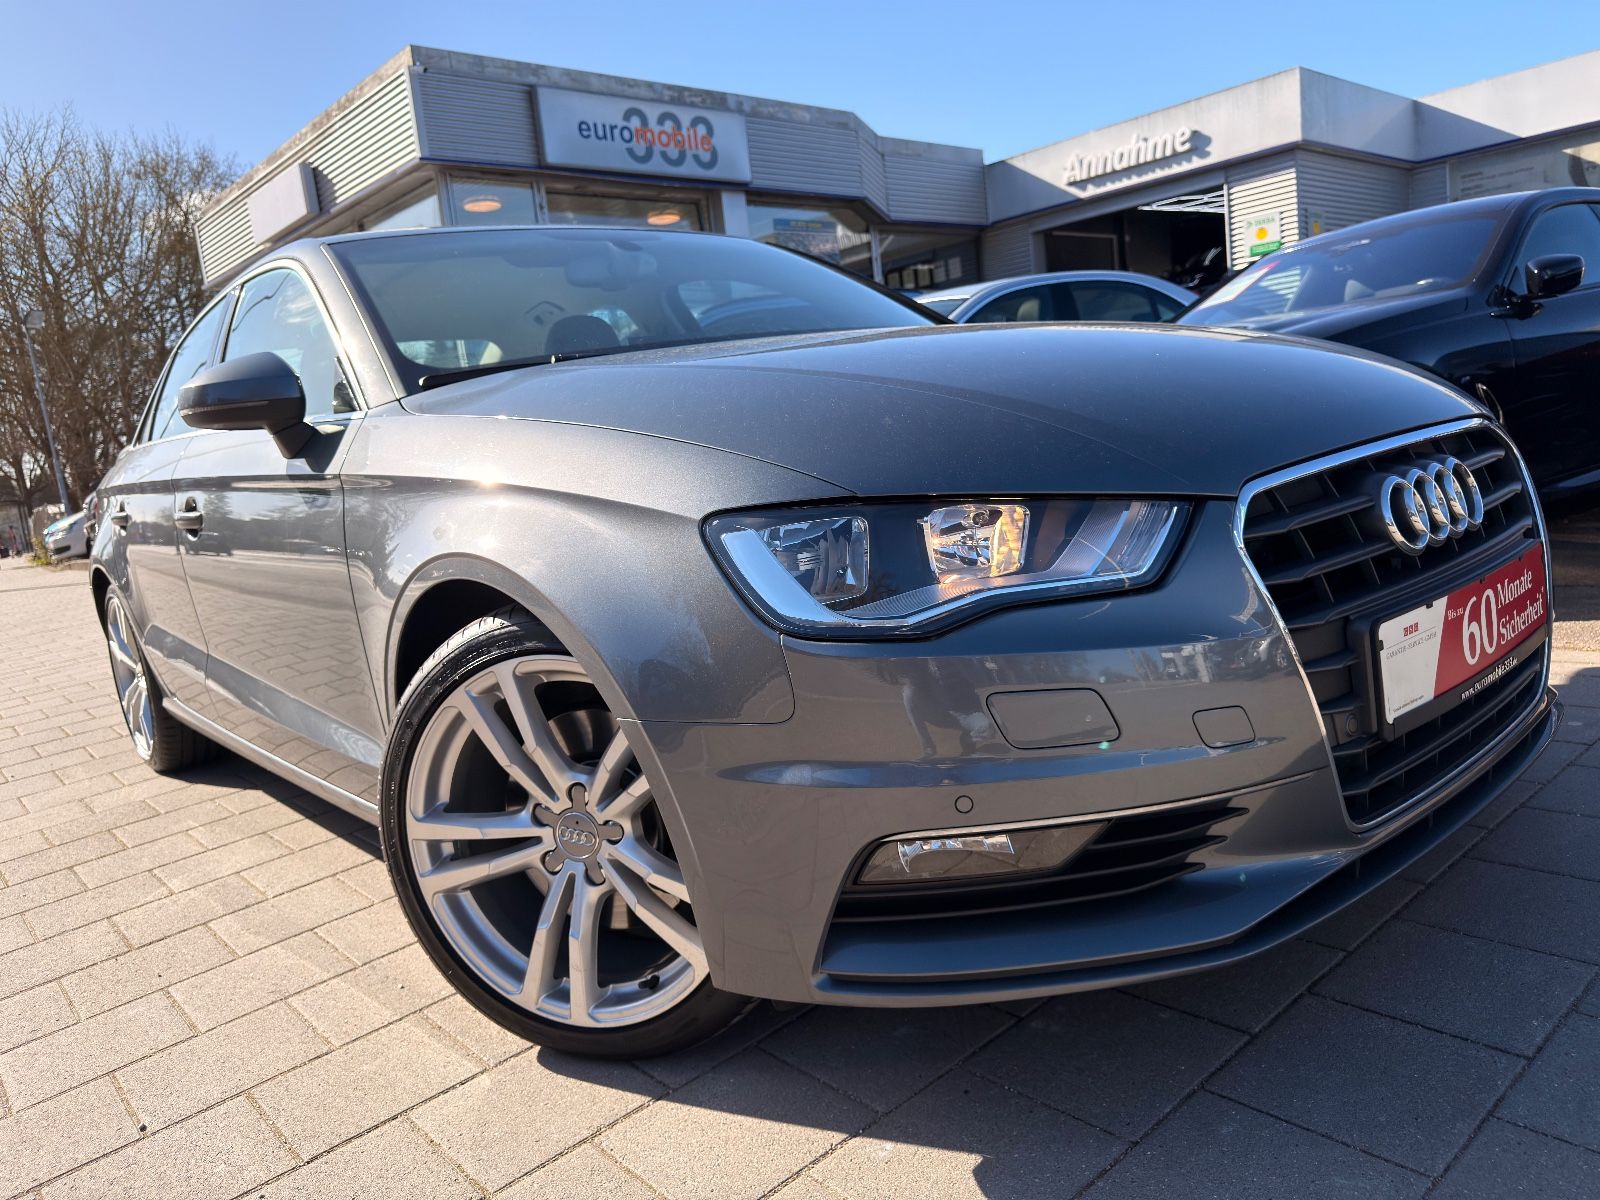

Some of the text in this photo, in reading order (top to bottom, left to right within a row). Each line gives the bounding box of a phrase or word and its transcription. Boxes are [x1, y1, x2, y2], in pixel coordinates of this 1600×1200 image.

[578, 119, 714, 152] euromobile
[622, 107, 719, 171] 333
[1063, 126, 1193, 186] Annahme
[1496, 568, 1532, 609] Monate
[1462, 588, 1498, 665] 60
